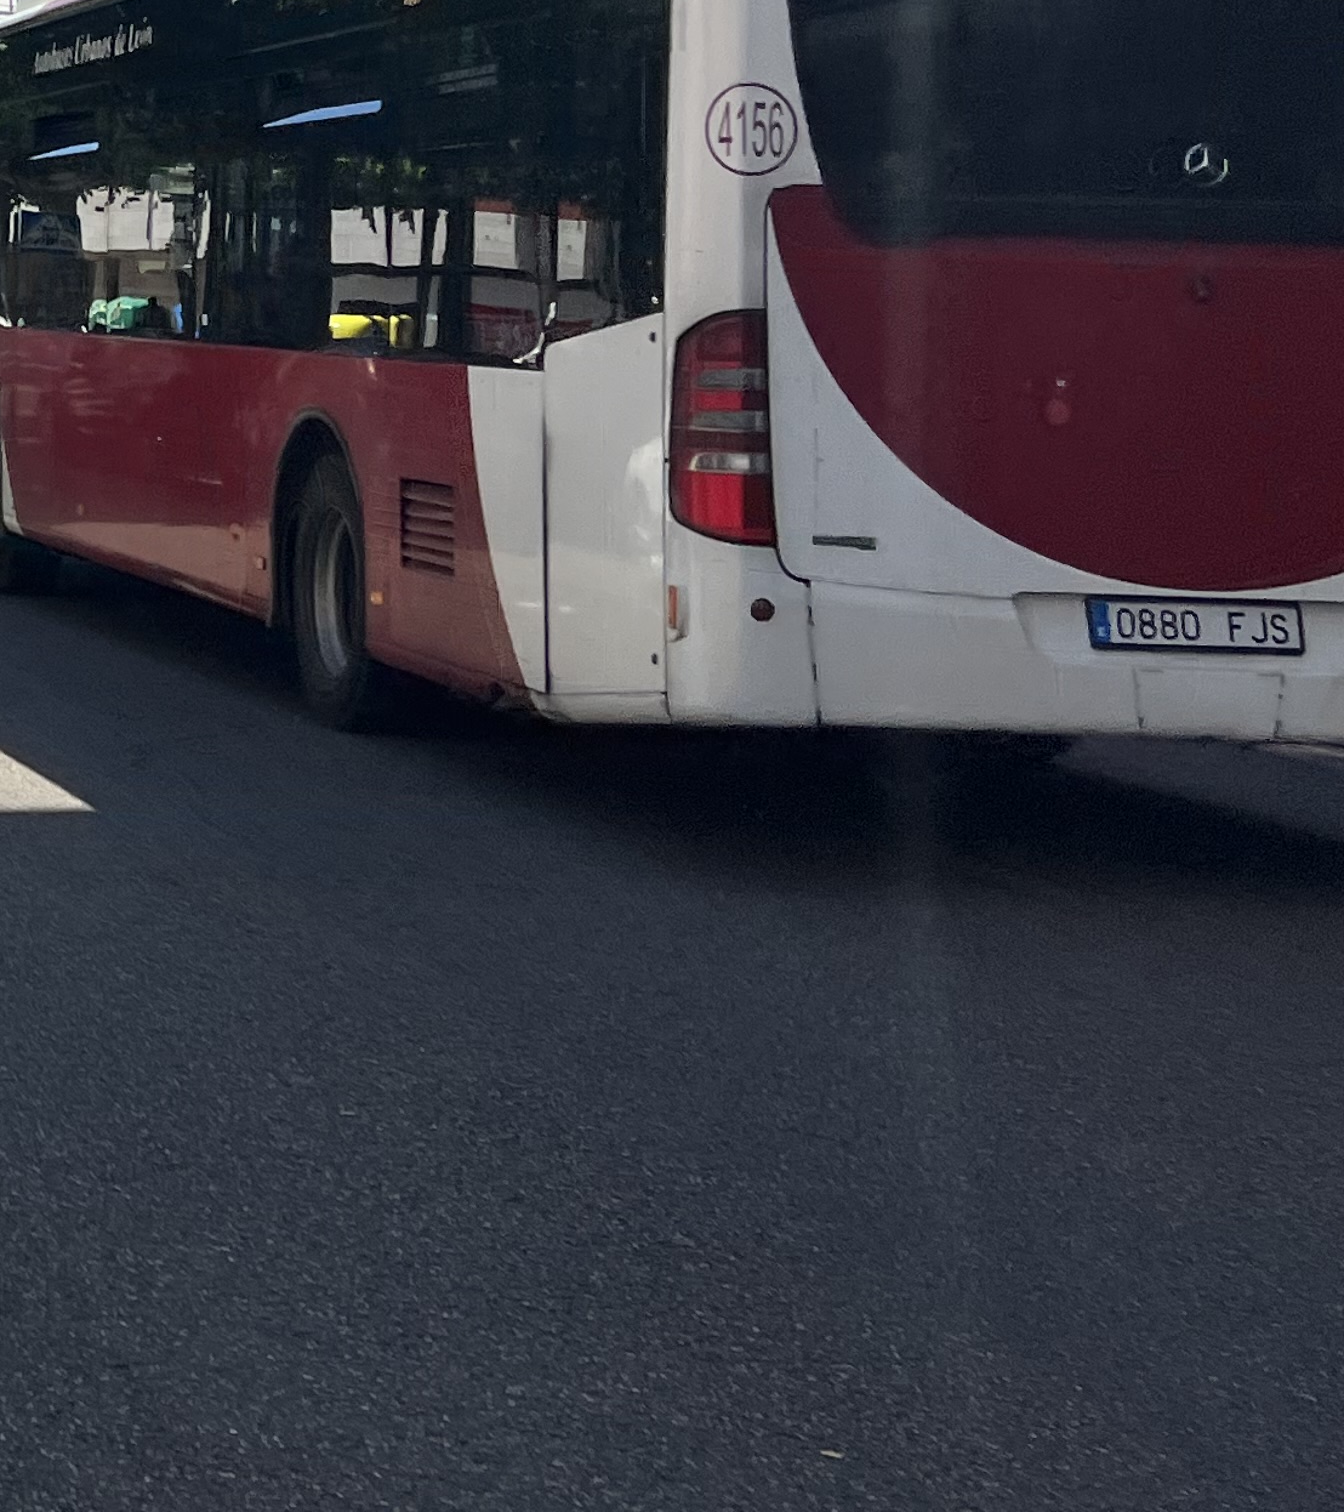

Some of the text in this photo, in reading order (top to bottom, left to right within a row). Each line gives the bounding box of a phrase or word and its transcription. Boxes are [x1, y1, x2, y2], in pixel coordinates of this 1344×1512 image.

[718, 101, 784, 157] 4156
[1117, 608, 1290, 644] 0880 FJS
